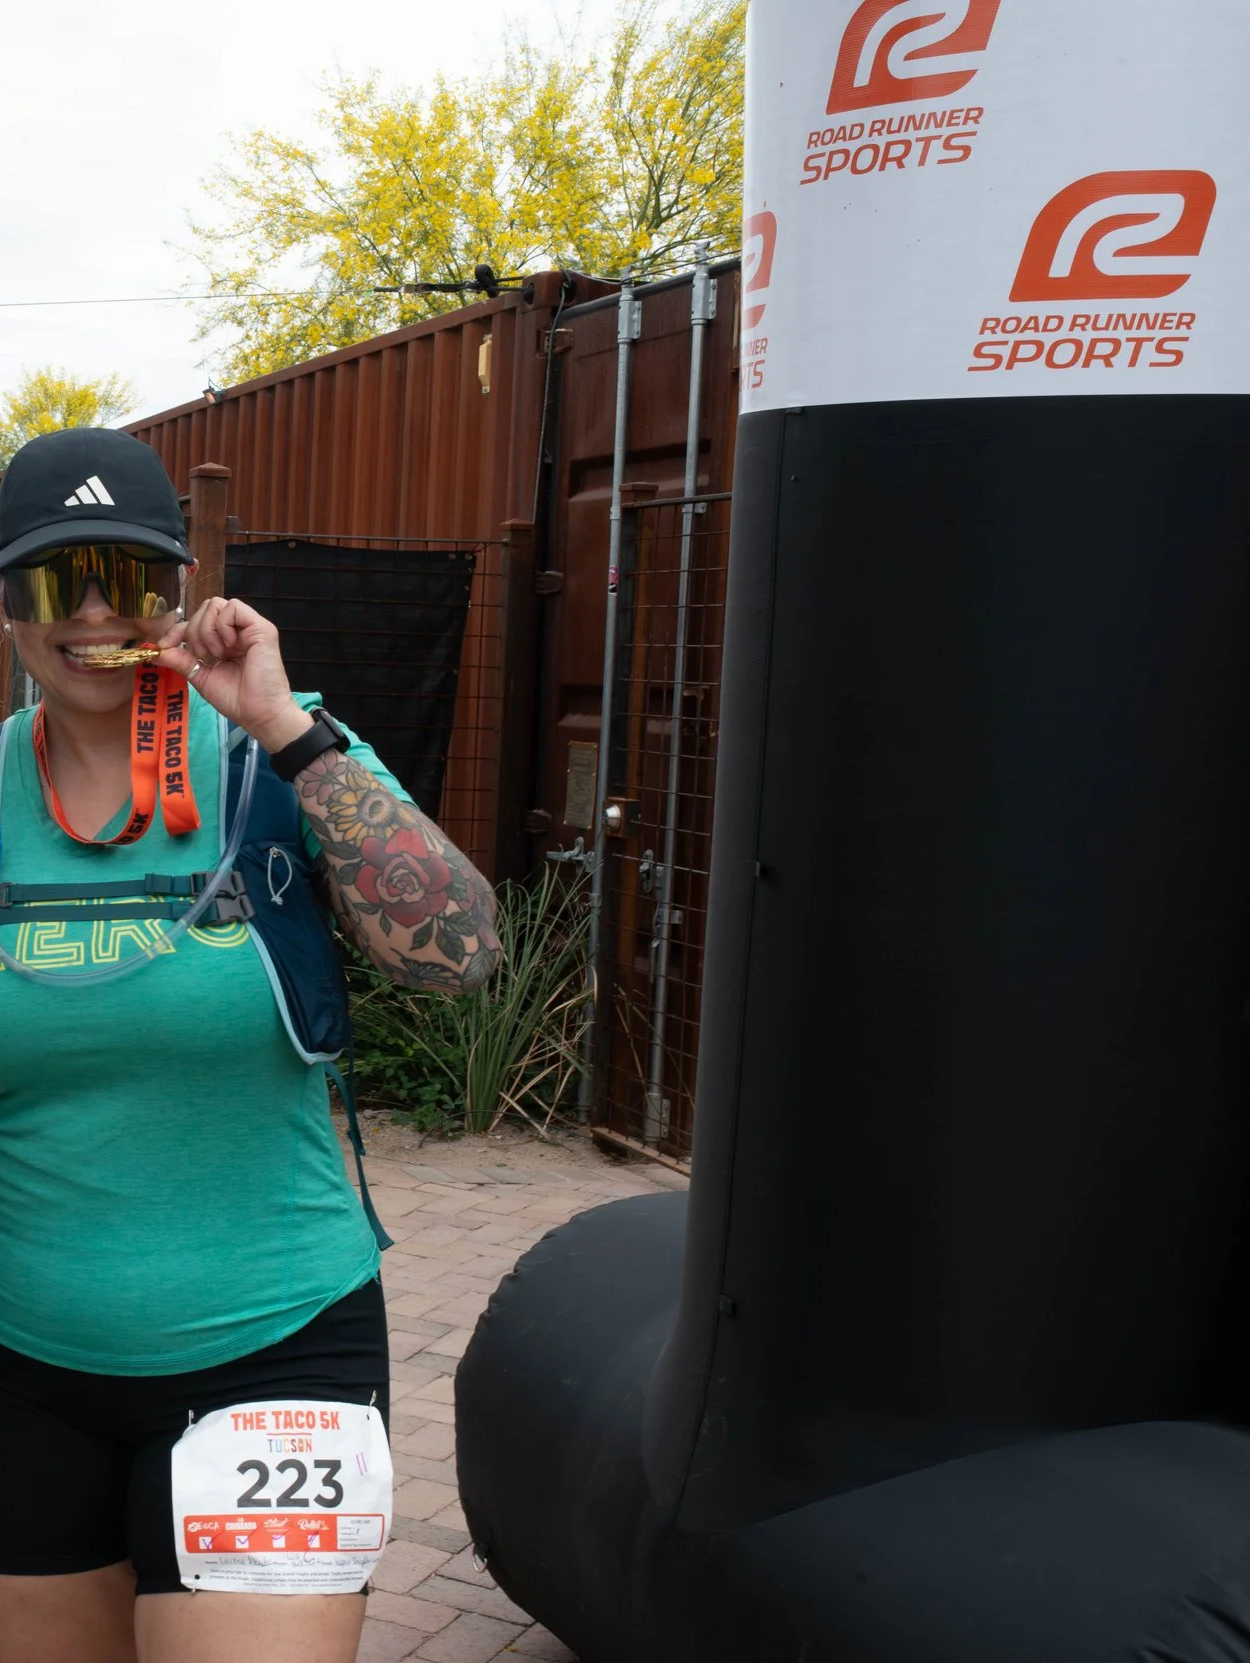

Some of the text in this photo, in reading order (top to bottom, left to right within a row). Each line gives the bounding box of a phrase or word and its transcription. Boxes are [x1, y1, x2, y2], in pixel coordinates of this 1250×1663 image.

[806, 106, 984, 150] ROAD RUNNER
[799, 131, 978, 186] SPORTS
[978, 312, 1196, 336] ROAD RUNNER
[967, 336, 1190, 372] SPORTS
[138, 669, 159, 715] TACO
[166, 690, 184, 724] THE
[137, 719, 155, 754] THE
[165, 725, 182, 768] TACO
[230, 1410, 340, 1432] THE TACO 5K
[267, 1438, 313, 1453] TUCSON
[236, 1458, 344, 1509] 223
